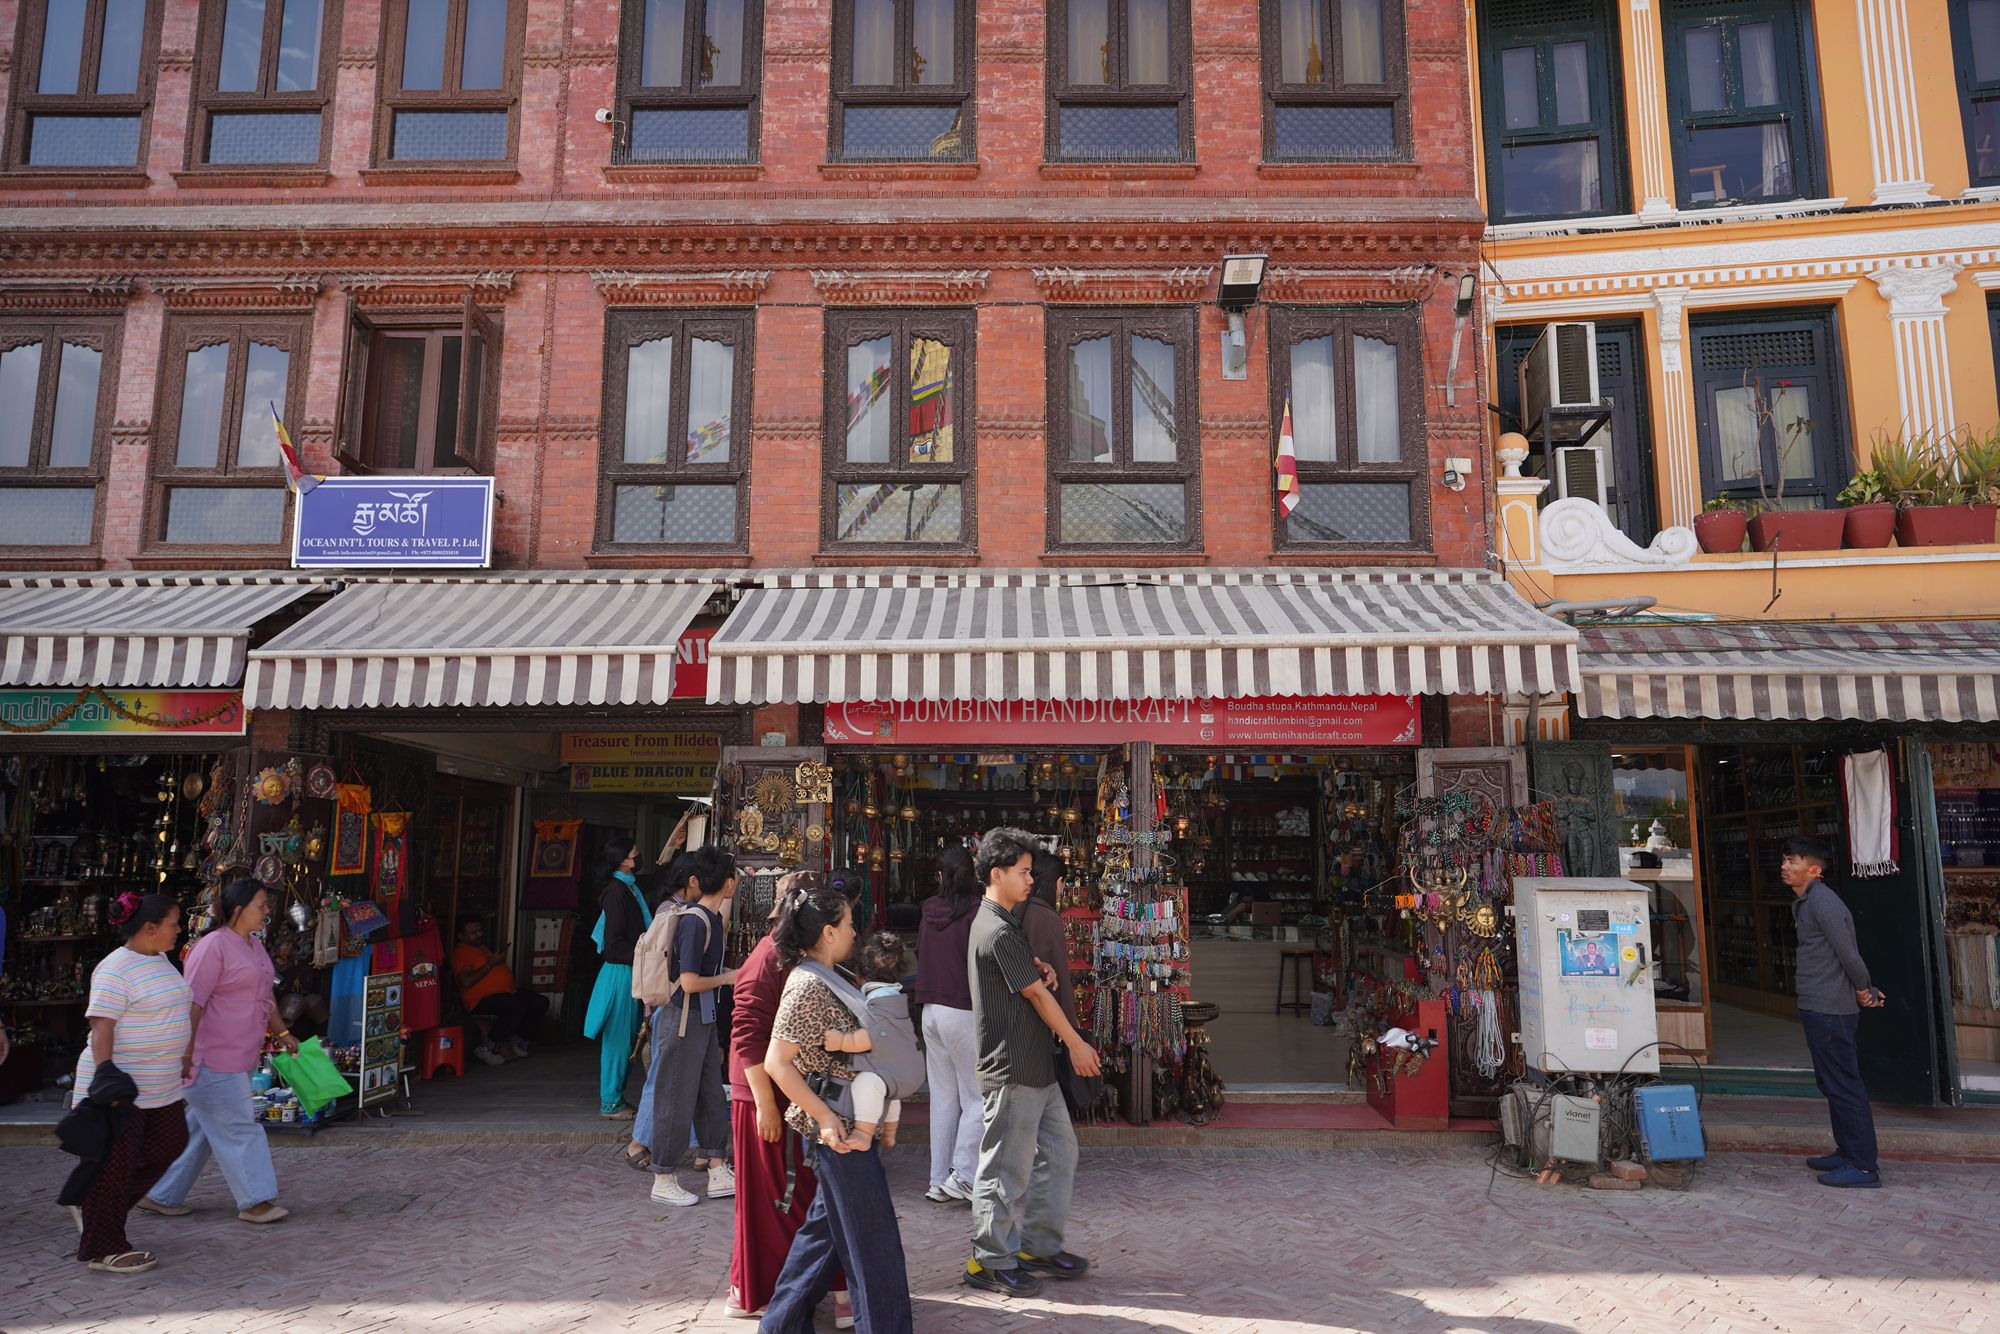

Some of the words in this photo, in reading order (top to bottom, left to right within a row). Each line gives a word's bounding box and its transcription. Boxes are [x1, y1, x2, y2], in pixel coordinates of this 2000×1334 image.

[303, 538, 337, 547] OCEAN
[367, 538, 399, 547] TOURS
[401, 538, 409, 547] &
[412, 538, 450, 547] TRAVEL
[452, 538, 461, 547] P.
[463, 538, 480, 547] Ltd.
[899, 698, 1013, 723] LUMBINI
[1022, 698, 1196, 723] HANDICRAFT
[1227, 701, 1264, 711] Boudha
[1227, 715, 1363, 727] handicraftlumbini@gmail.com
[1228, 731, 1363, 740] www.lumbinihandicraft.com
[571, 735, 630, 748] Treasure
[635, 734, 668, 747] From
[630, 749, 655, 757] Inside
[657, 749, 677, 758] shop
[592, 767, 629, 778] BLUE
[635, 767, 694, 778] DRAGON
[415, 979, 437, 988] NEPAL
